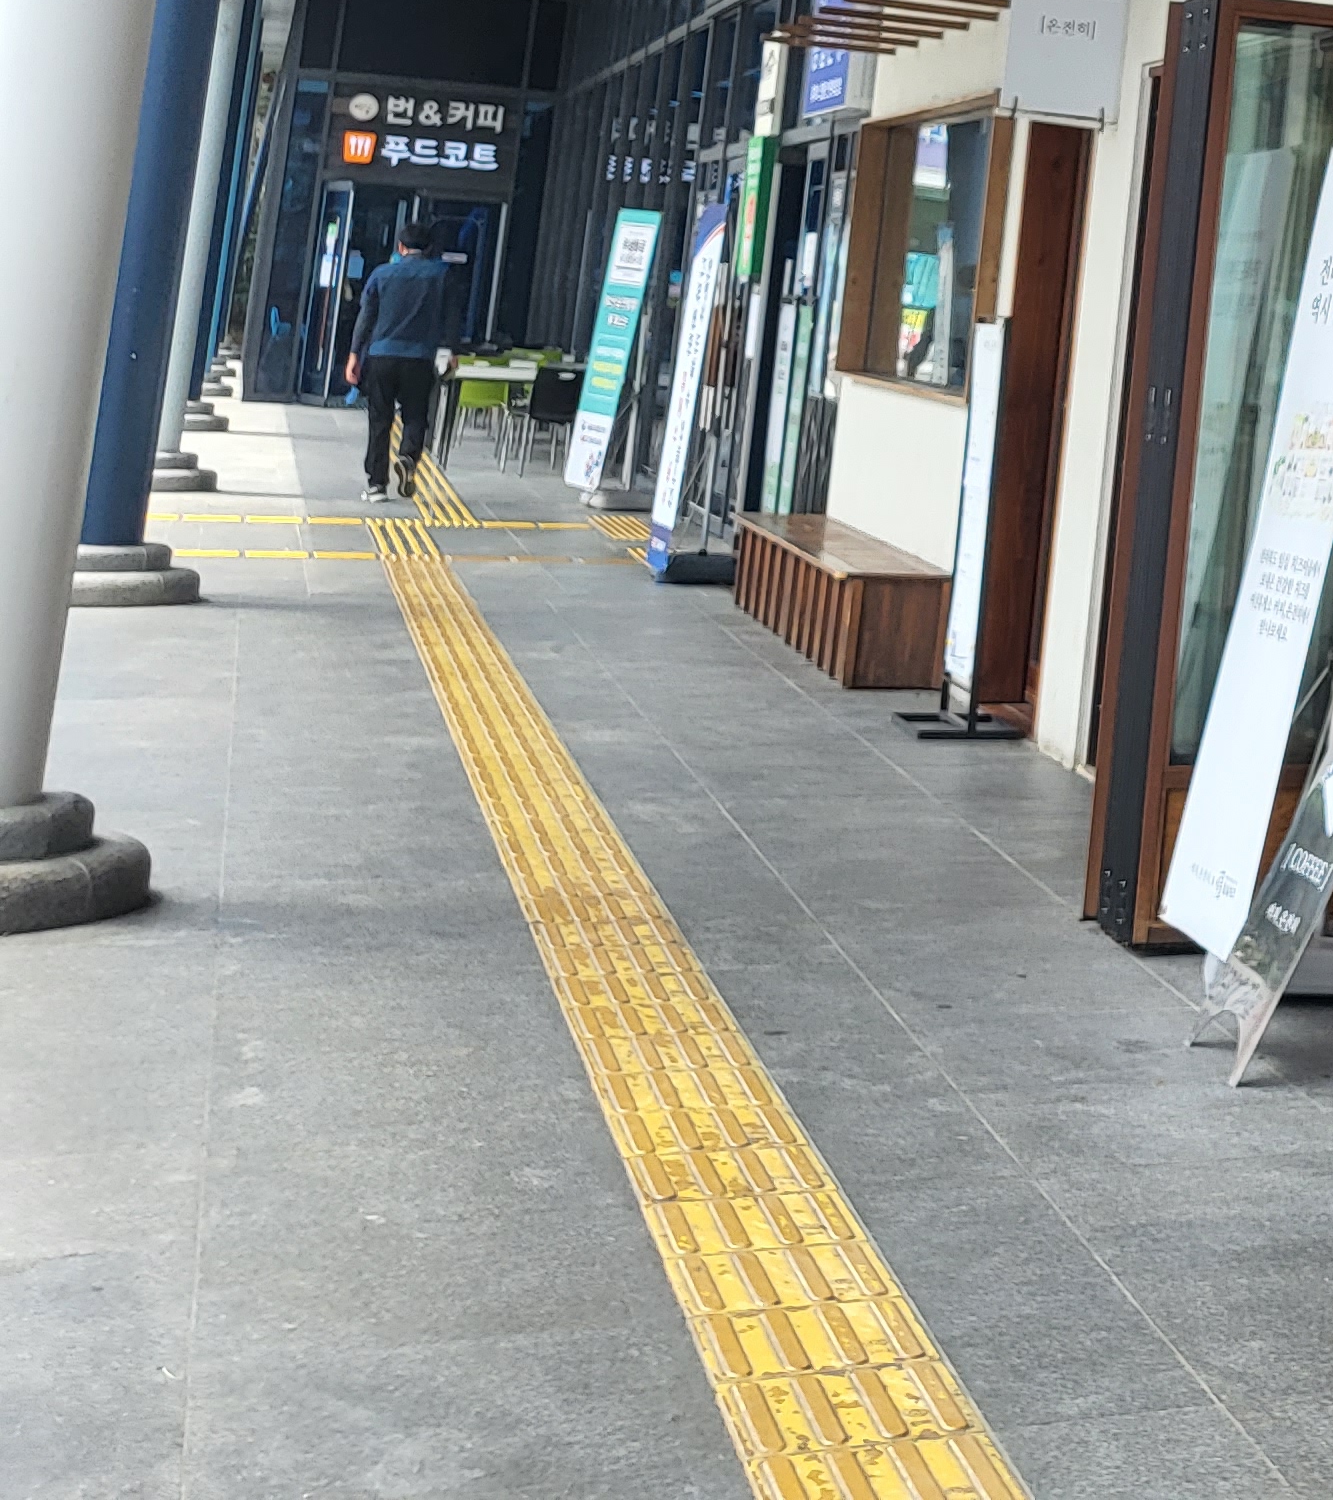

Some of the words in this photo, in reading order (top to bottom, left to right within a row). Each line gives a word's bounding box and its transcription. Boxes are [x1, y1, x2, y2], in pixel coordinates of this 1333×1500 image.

[387, 95, 505, 134] 번&커피
[381, 133, 499, 171] 푸드코트
[1311, 293, 1333, 325] 역시
